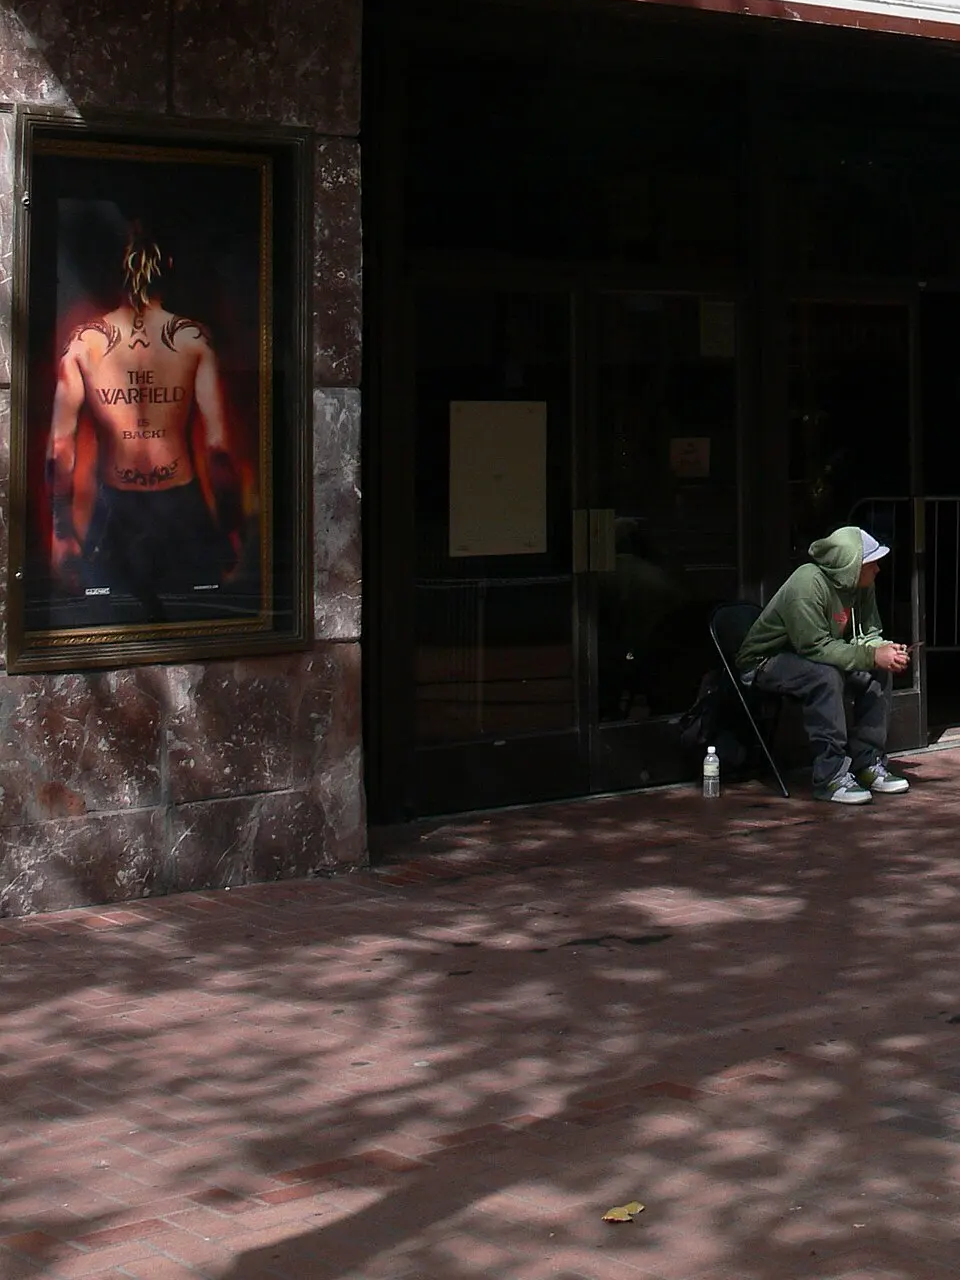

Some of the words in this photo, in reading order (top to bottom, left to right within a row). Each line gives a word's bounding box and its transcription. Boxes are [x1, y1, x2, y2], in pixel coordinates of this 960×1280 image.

[127, 370, 155, 385] THE
[96, 386, 186, 405] WARFIELD
[137, 418, 150, 427] IS
